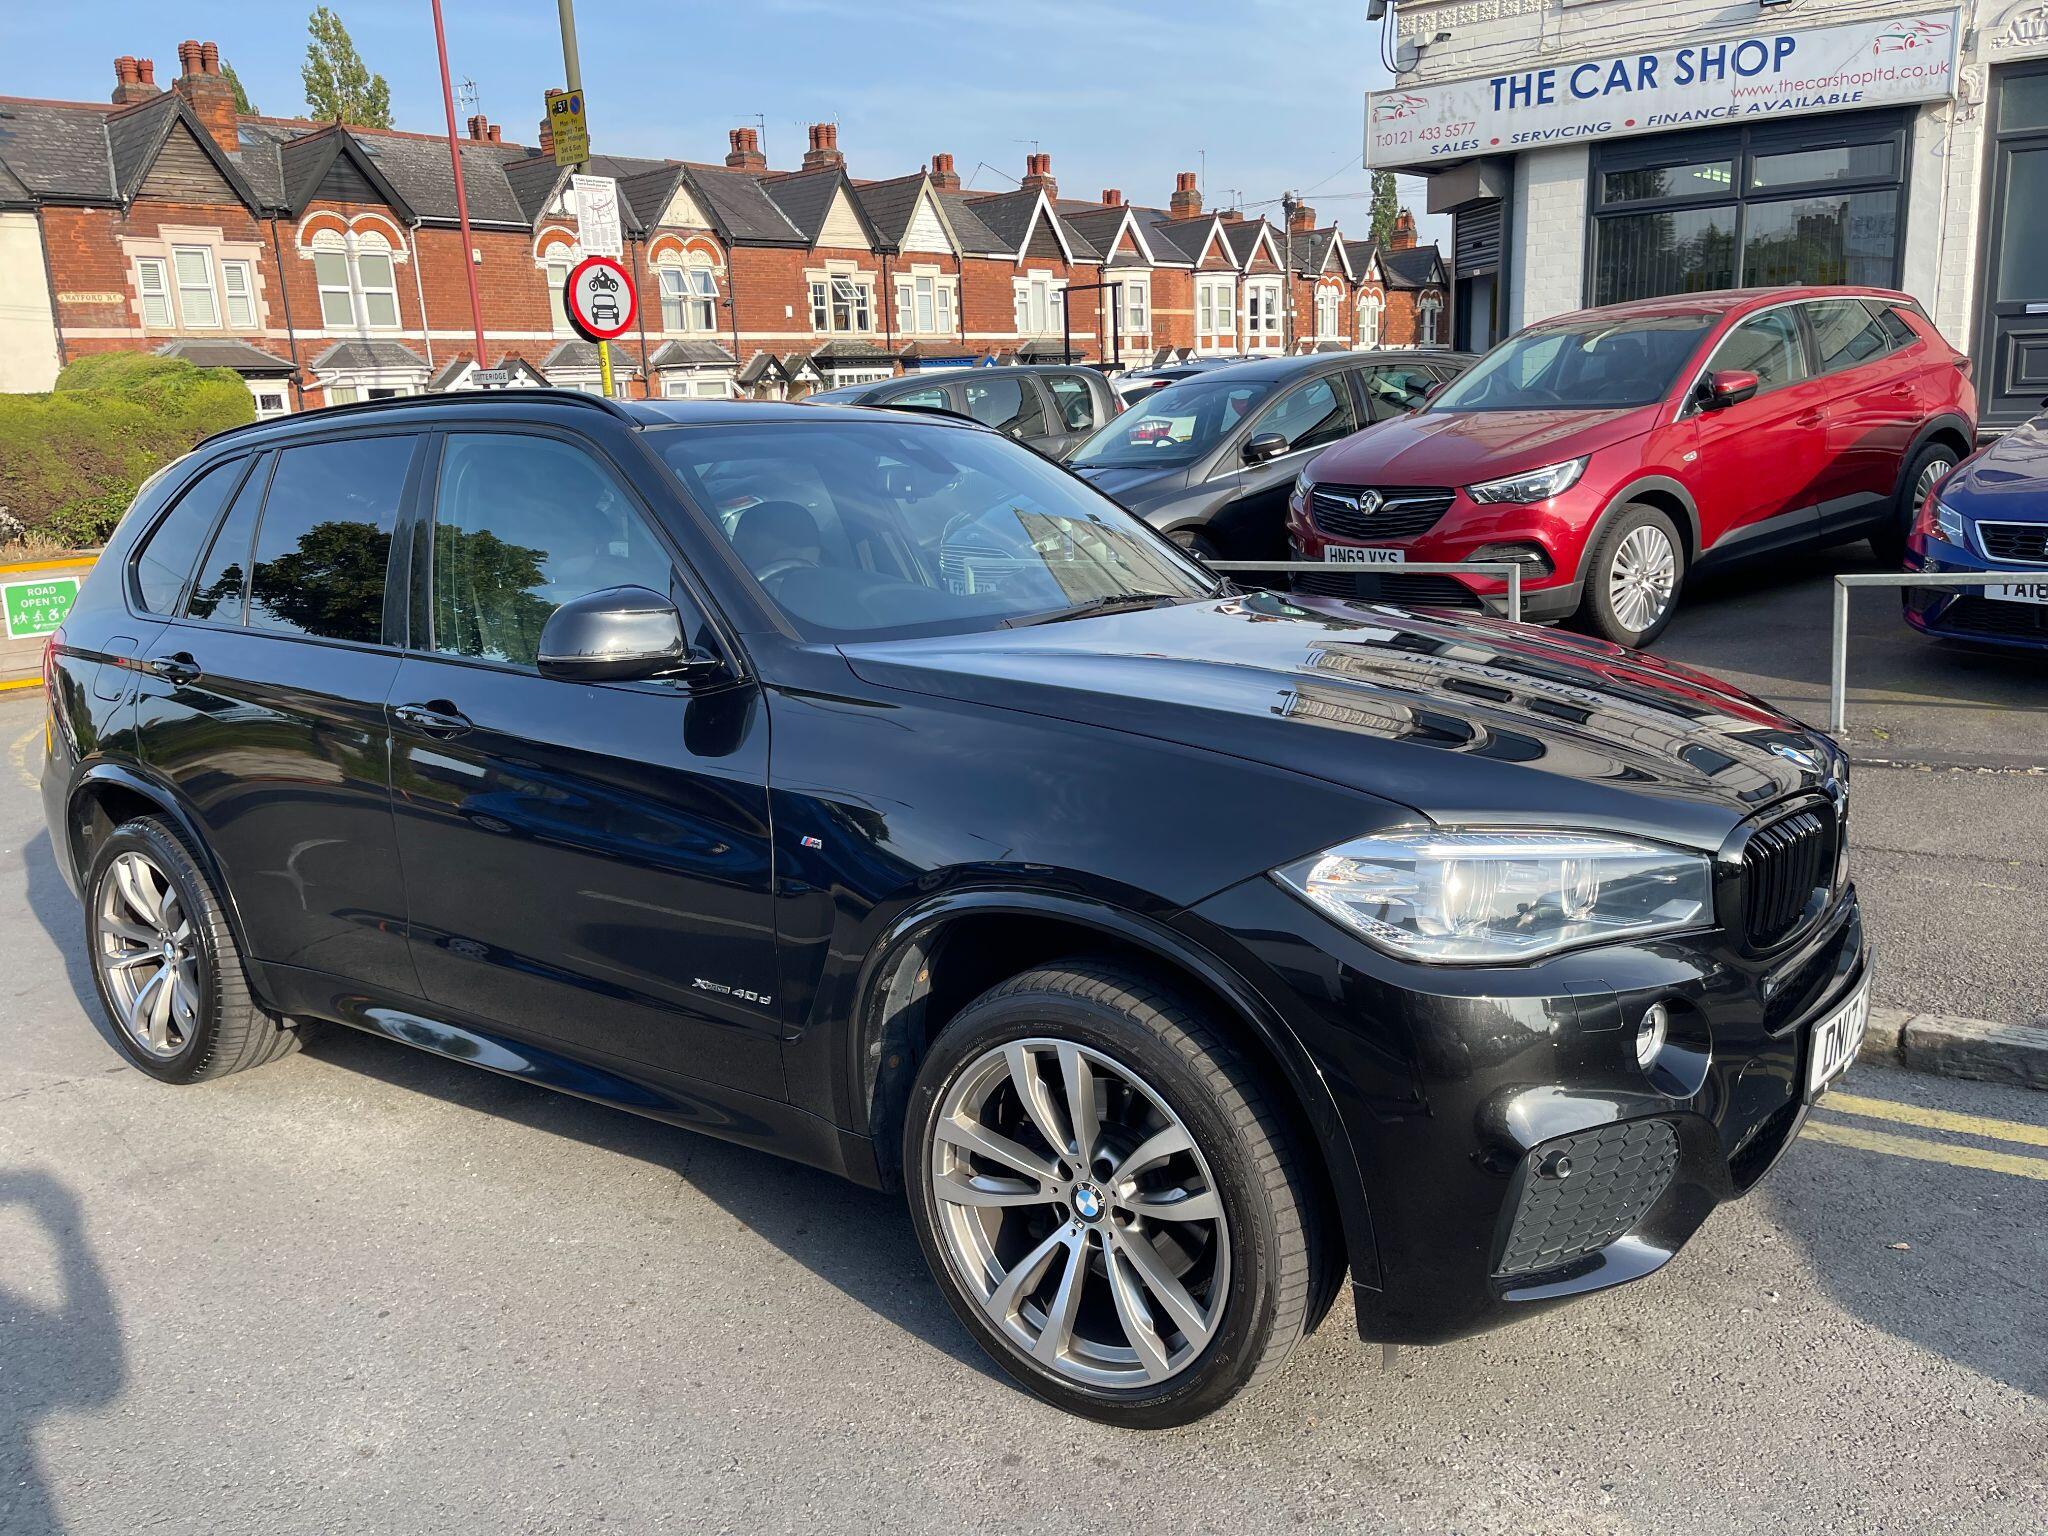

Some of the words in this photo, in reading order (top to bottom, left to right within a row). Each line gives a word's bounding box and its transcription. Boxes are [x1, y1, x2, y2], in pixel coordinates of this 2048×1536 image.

[1491, 70, 1555, 111] THE
[1570, 54, 1659, 99] CAR
[1674, 36, 1796, 86] SHOP
[1731, 60, 1949, 98] www.thecarshopltd.co.uk
[1376, 130, 1413, 147] T:0121
[1419, 126, 1441, 141] 433
[1445, 122, 1476, 137] 5577
[1430, 139, 1480, 154] SALES
[1511, 122, 1611, 144] SERVICING
[1647, 105, 1739, 126] FINANCE
[1746, 91, 1863, 114] AVAILABLE
[1329, 547, 1365, 562] HN69
[20, 598, 50, 608] OPEN
[52, 595, 66, 605] TO
[27, 586, 57, 596] ROAD
[1076, 1183, 1105, 1207] BMW
